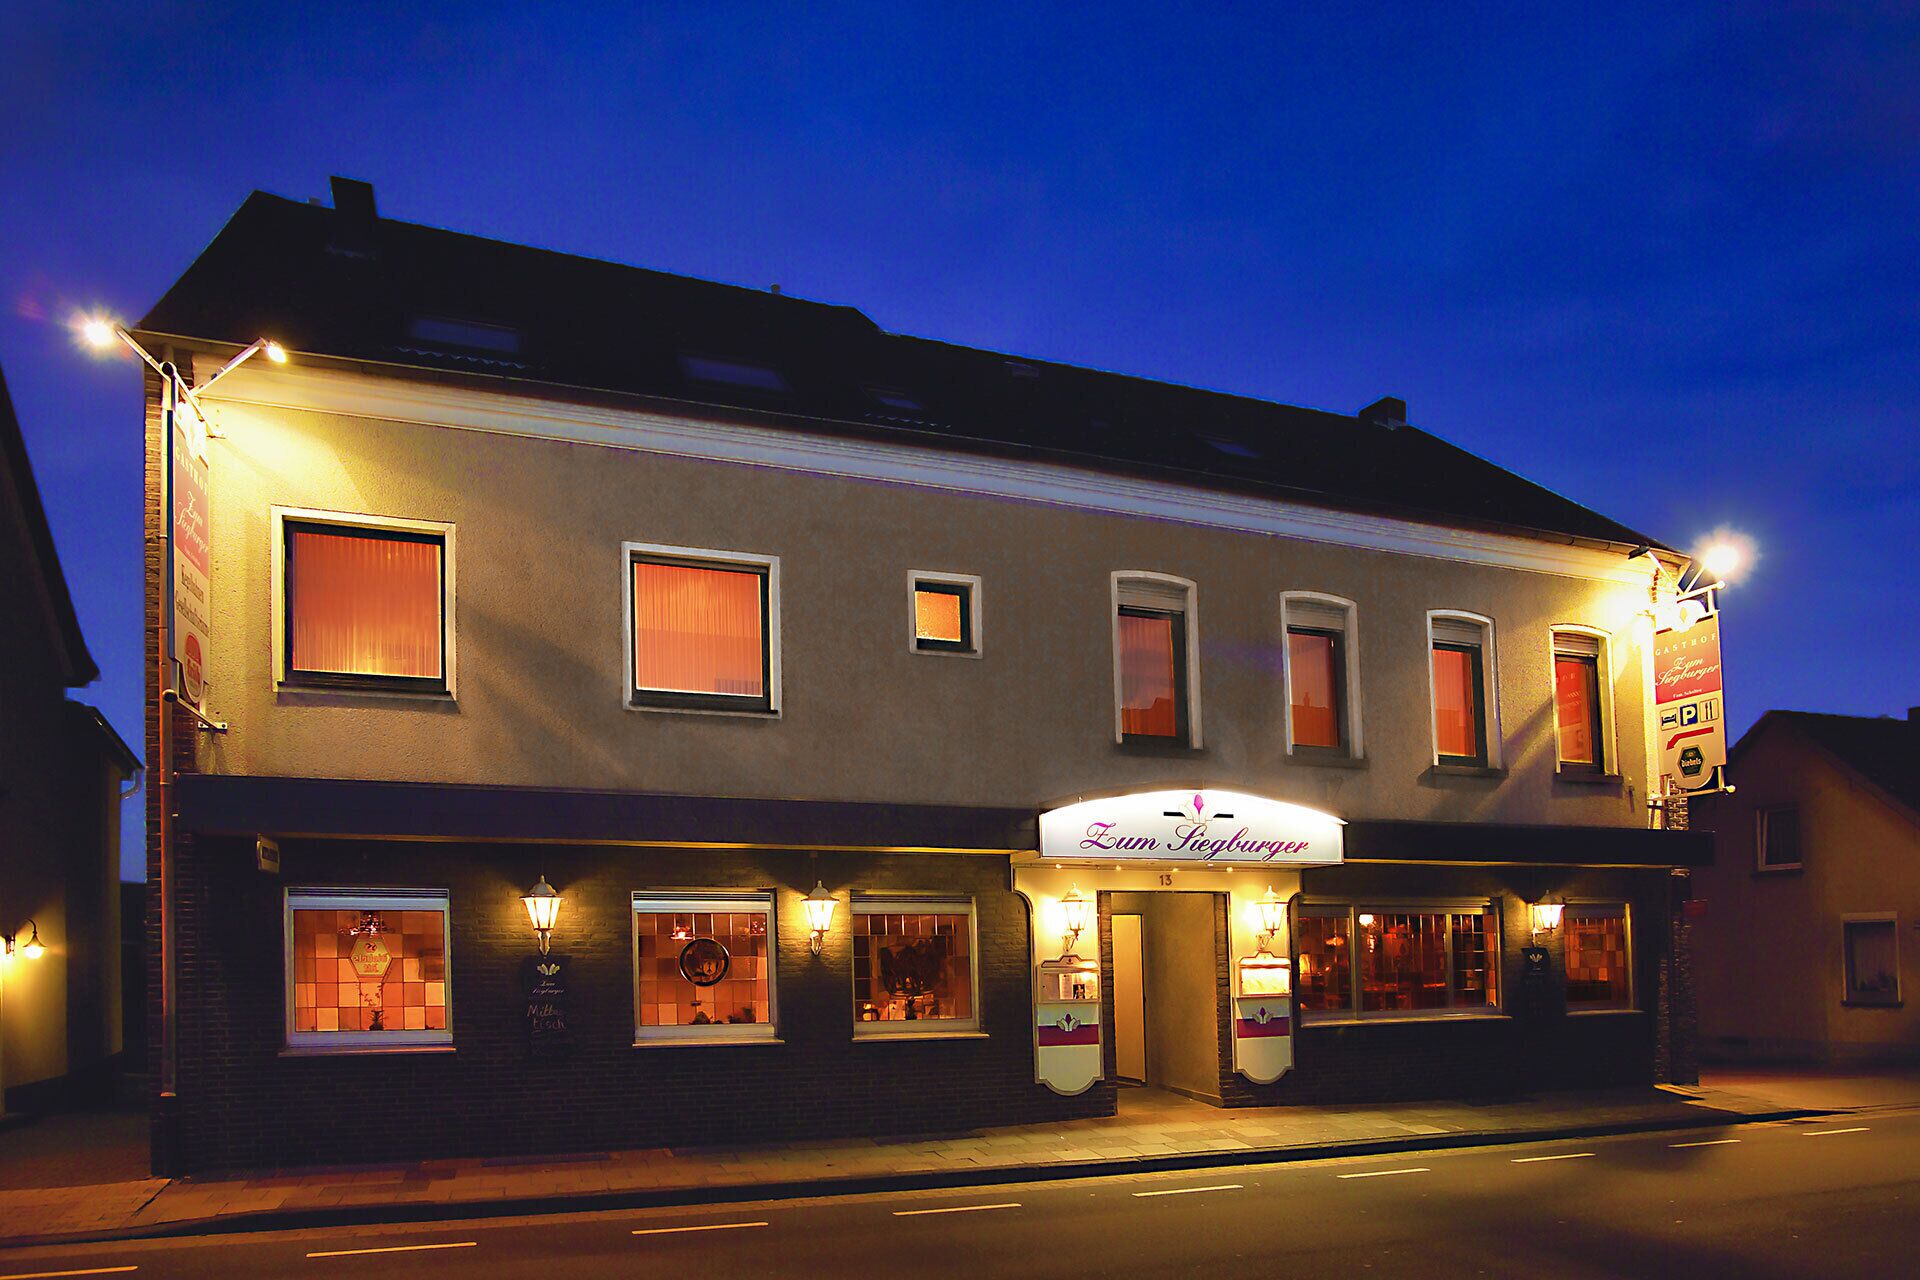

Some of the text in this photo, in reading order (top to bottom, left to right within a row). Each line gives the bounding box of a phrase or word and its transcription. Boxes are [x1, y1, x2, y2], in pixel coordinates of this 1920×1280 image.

[176, 446, 208, 497] GASTHOF
[1655, 633, 1716, 656] GASTHOF
[1655, 663, 1720, 687] Siegburger
[1673, 655, 1704, 672] Zum
[1682, 706, 1696, 725] P
[1080, 822, 1310, 862] Zum Siegburger
[1159, 874, 1172, 887] 13
